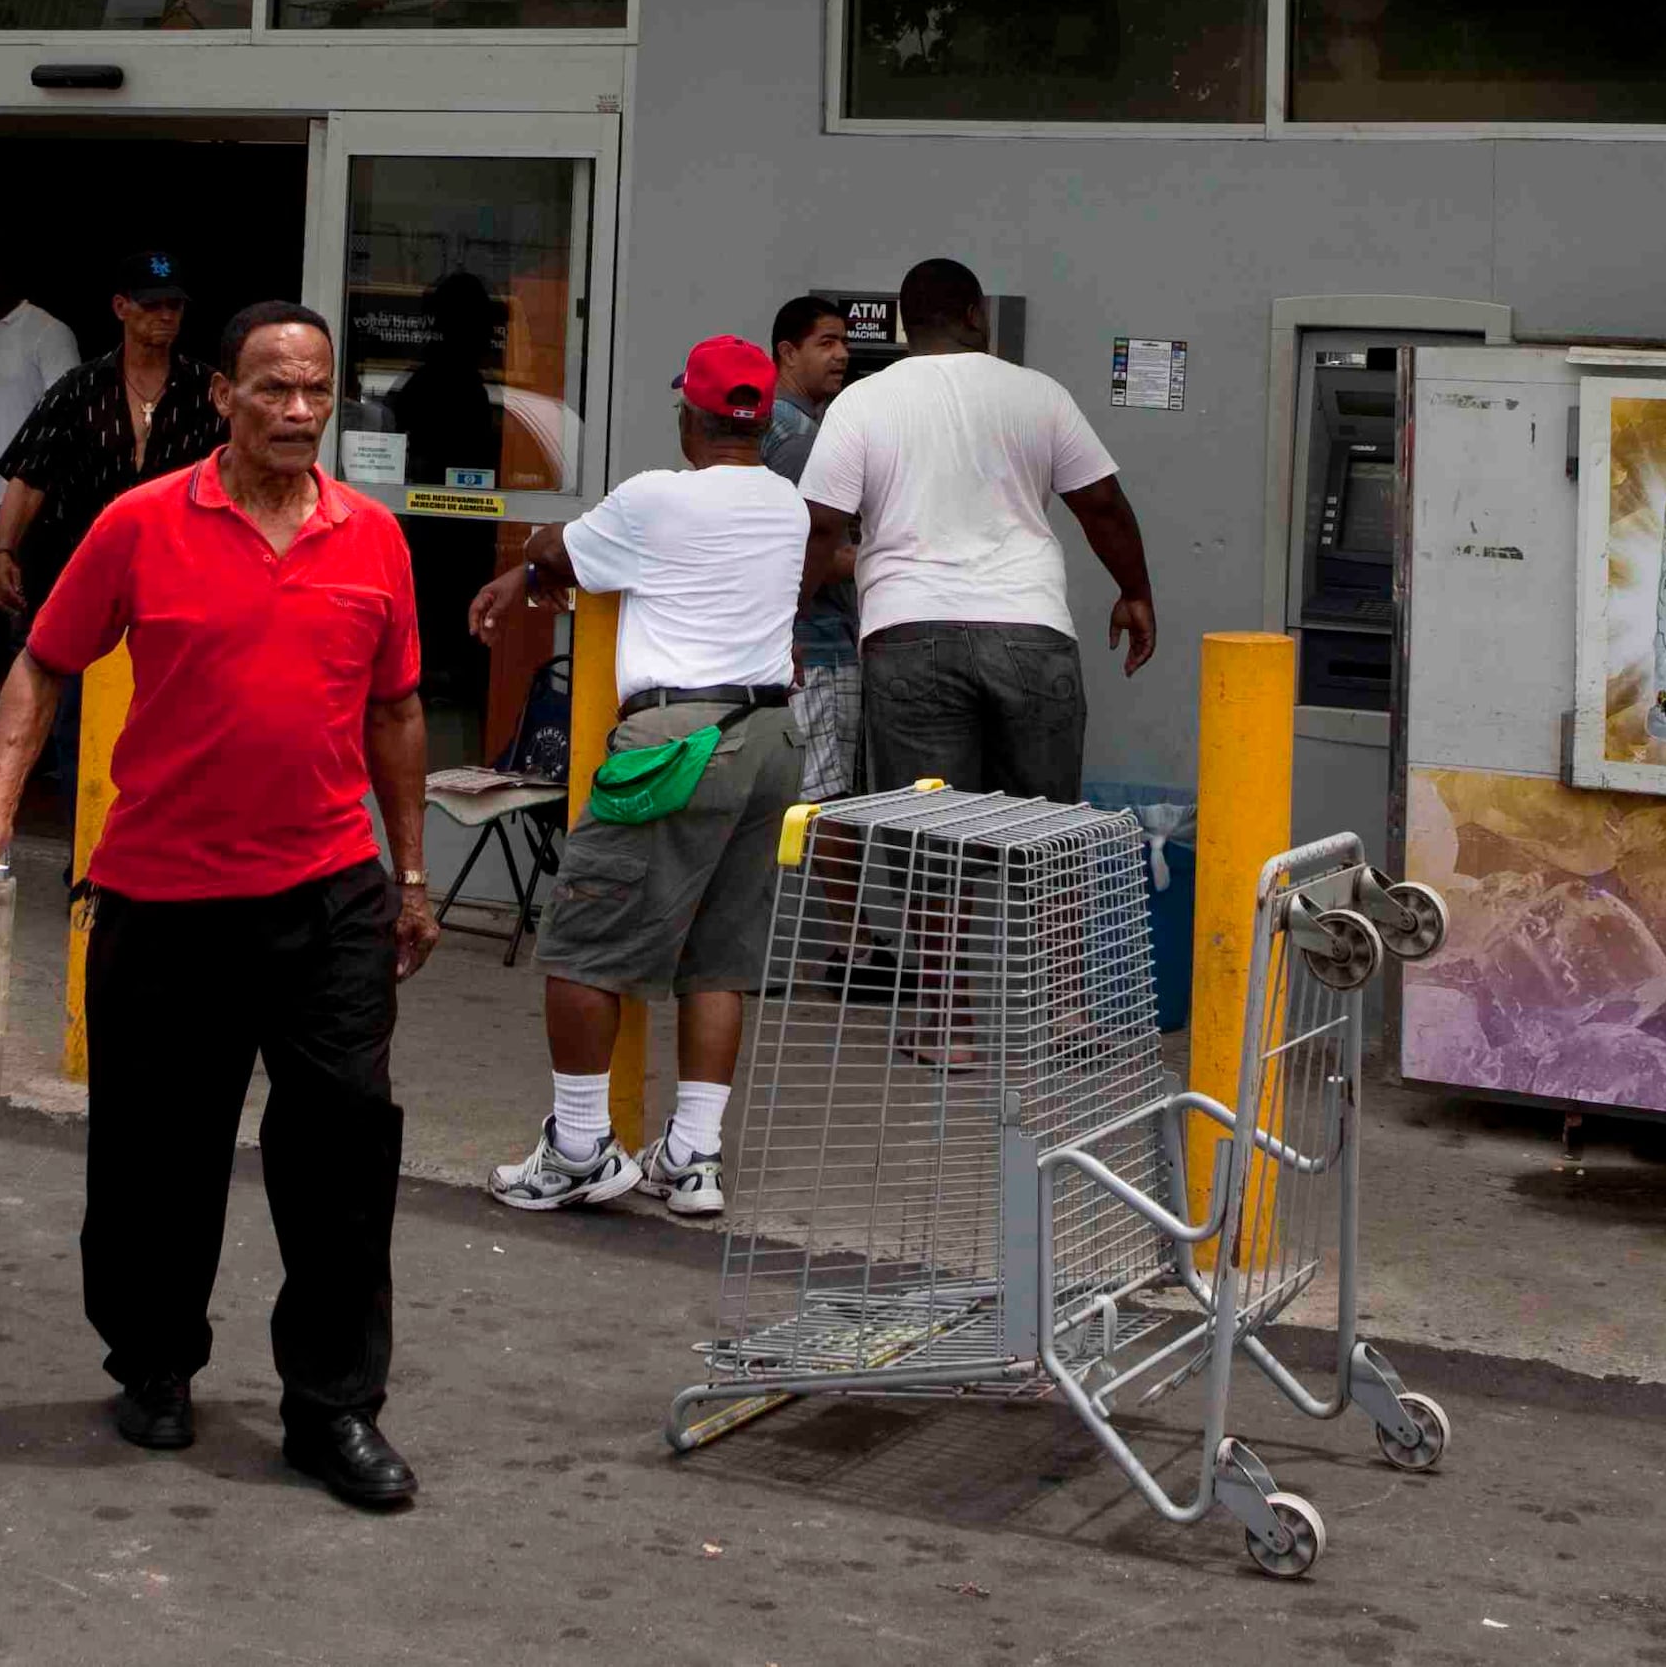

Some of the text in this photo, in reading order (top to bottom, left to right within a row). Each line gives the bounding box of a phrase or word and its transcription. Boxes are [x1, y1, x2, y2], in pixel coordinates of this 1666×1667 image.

[848, 302, 887, 320] ATM
[855, 322, 880, 332] CASH
[847, 330, 888, 341] MACHINE
